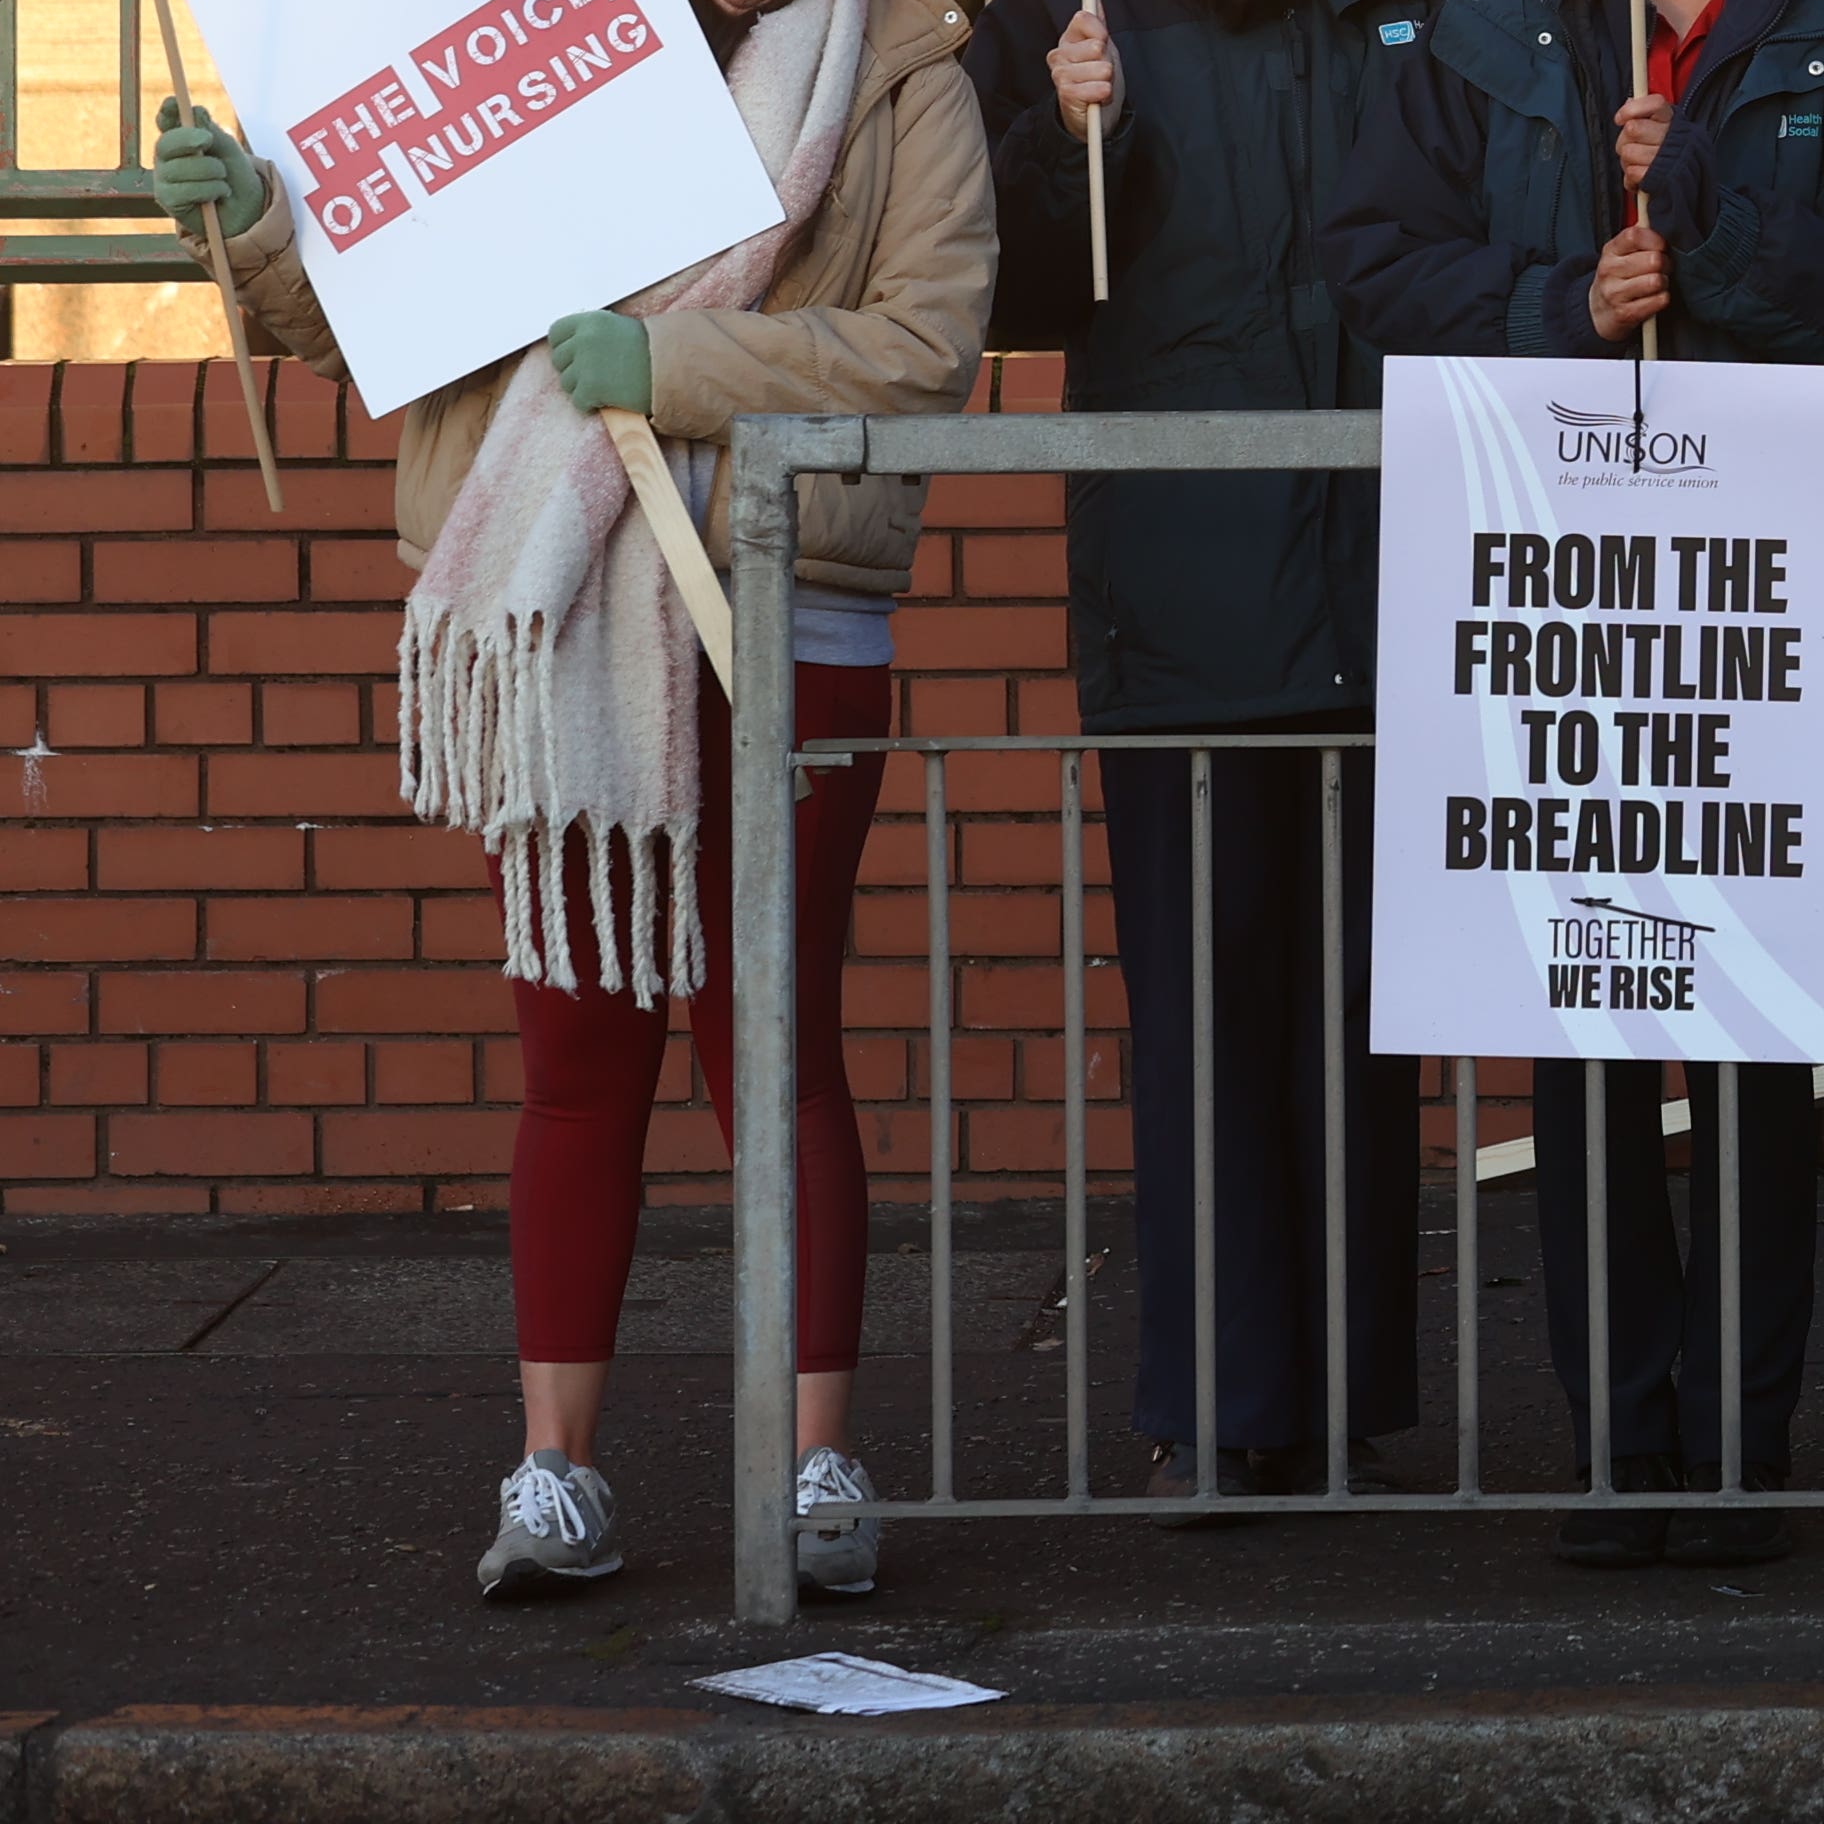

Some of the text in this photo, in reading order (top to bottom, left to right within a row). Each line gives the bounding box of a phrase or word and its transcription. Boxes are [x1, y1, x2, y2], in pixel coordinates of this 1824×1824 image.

[299, 81, 415, 172] THE
[320, 11, 649, 235] OF NURSING
[1788, 113, 1822, 125] Health
[1788, 126, 1818, 137] Social
[1558, 430, 1706, 465] UNISON
[1558, 472, 1719, 489] the public service union
[1471, 532, 1788, 613] FROM THE
[1453, 620, 1803, 703] FRONTLINE
[1521, 709, 1731, 788] TO THE
[1445, 795, 1804, 878] BREADLINE
[1547, 918, 1696, 961] TOGETHER
[1547, 964, 1695, 1011] WE RISE
